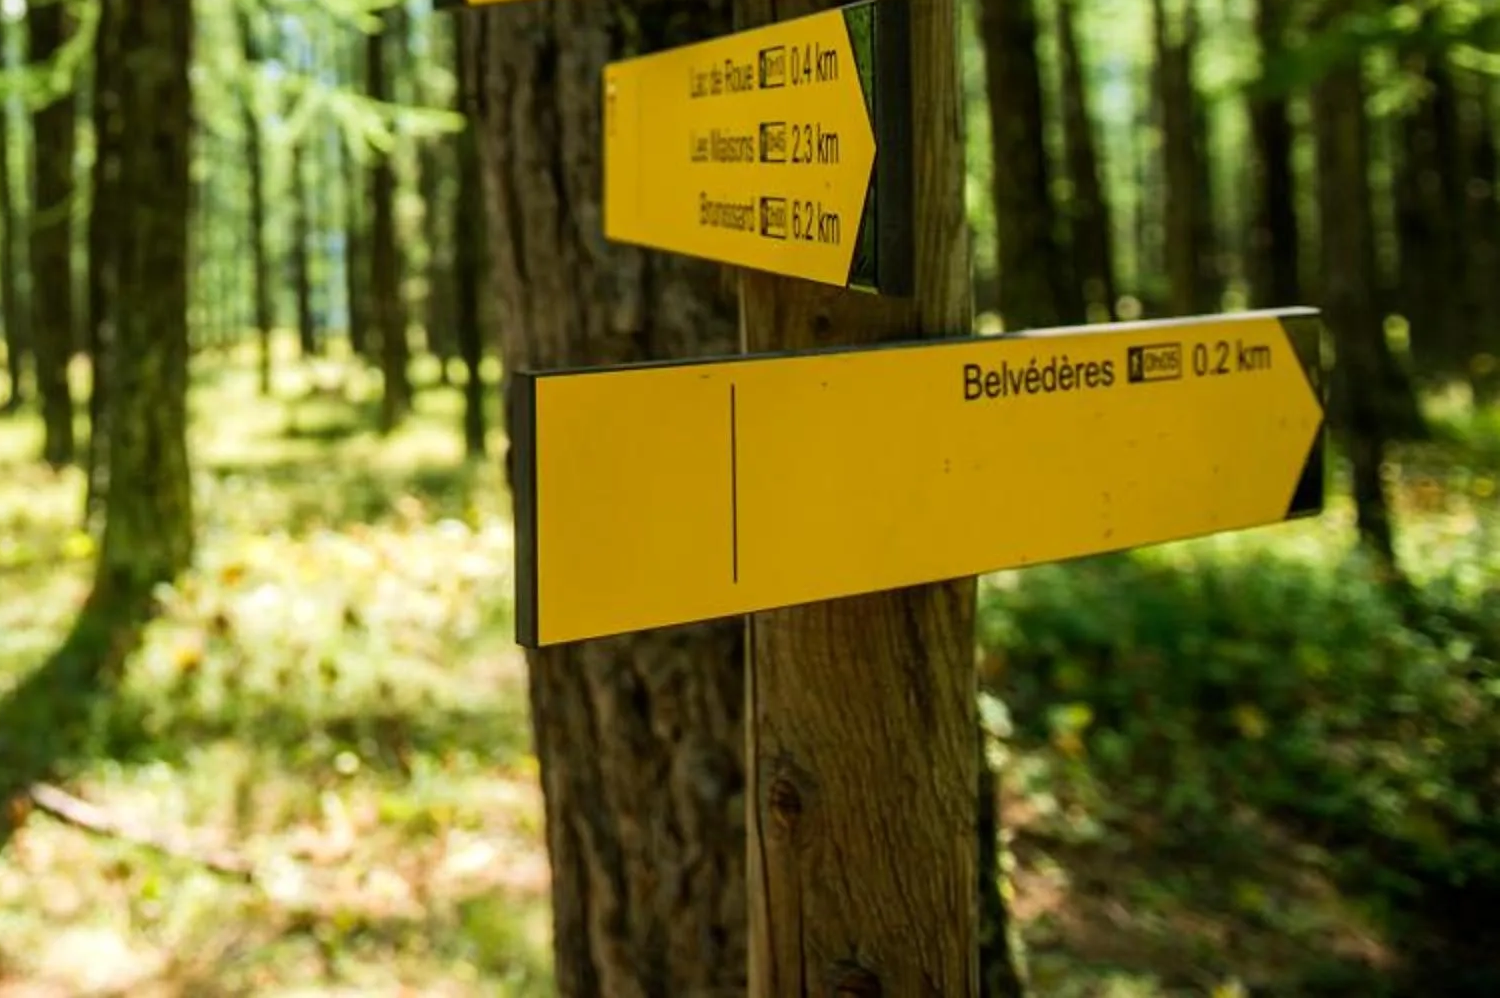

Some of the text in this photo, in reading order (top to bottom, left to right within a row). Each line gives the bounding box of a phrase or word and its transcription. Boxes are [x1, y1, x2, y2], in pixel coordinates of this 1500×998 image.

[724, 58, 754, 92] Roue
[790, 44, 812, 86] 0.4
[815, 42, 839, 84] km
[791, 123, 813, 164] 2.3
[816, 122, 840, 165] km
[792, 198, 814, 241] 6.2
[817, 200, 841, 245] km
[963, 354, 1115, 401] Belvédères
[1192, 341, 1230, 377] 0.2
[1237, 339, 1272, 372] km
